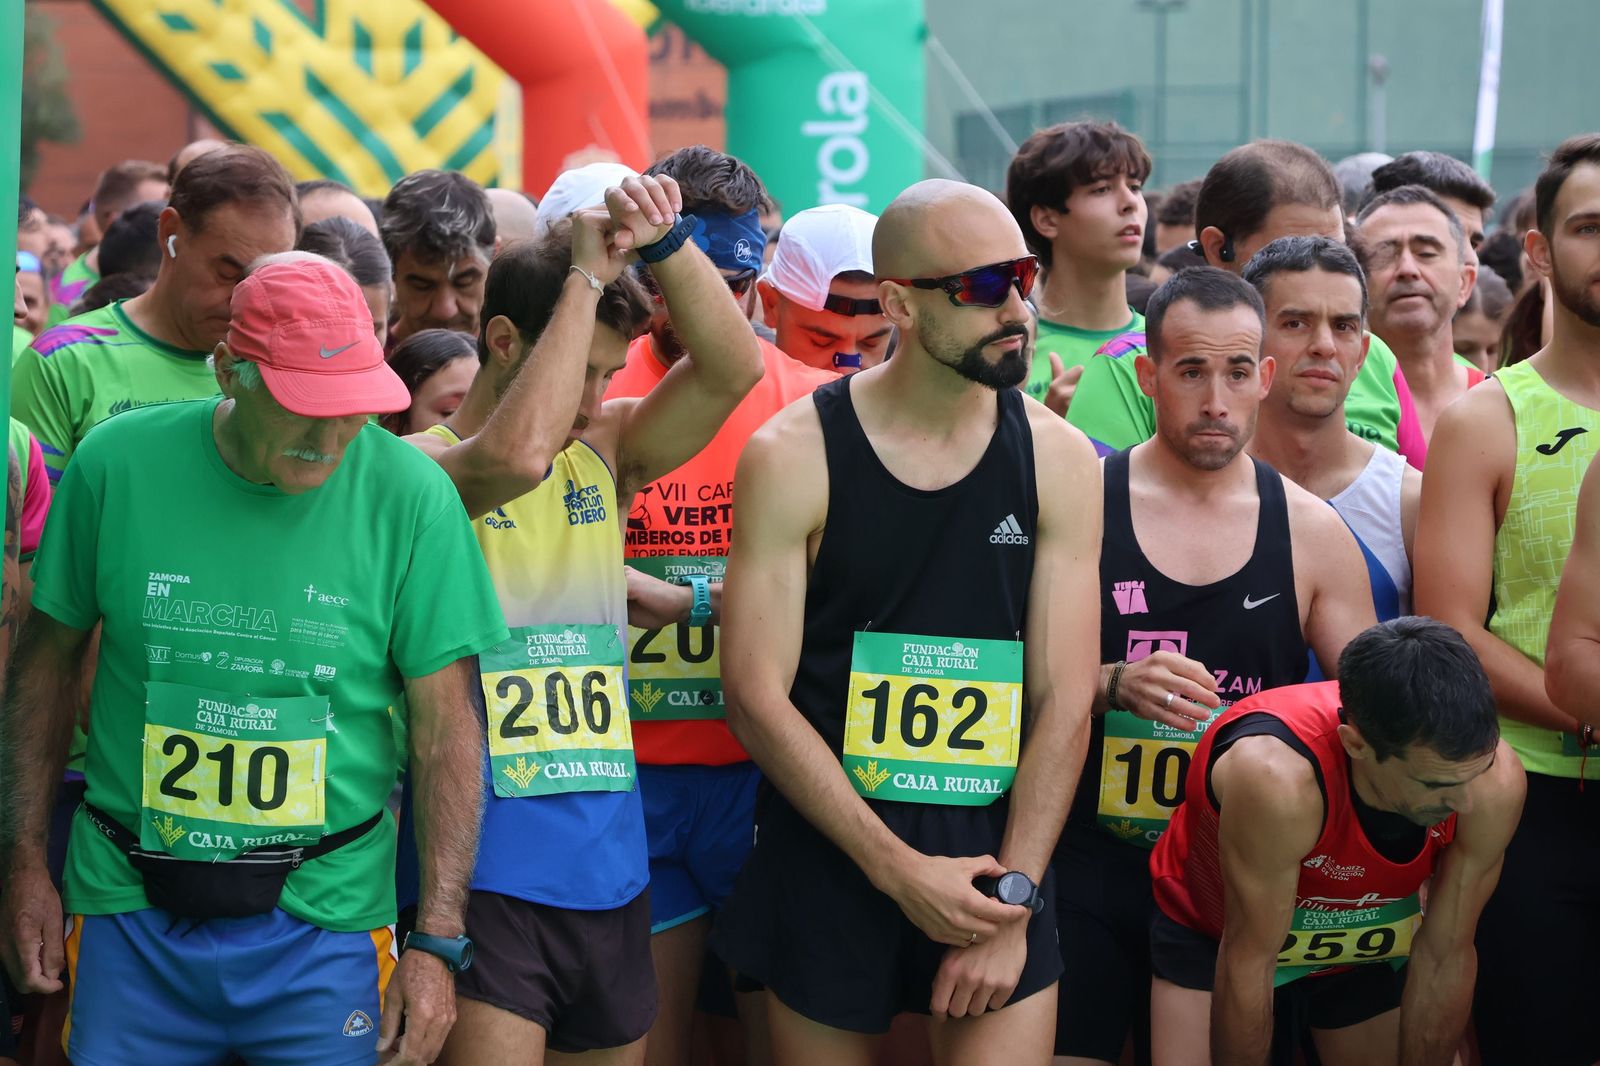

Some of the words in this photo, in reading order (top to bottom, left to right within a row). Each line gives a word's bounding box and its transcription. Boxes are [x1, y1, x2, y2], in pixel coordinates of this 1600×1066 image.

[657, 482, 686, 501] VII
[663, 503, 732, 526] VERT
[700, 529, 722, 546] DE
[989, 532, 1029, 545] adidas
[148, 572, 191, 584] ZAMORA
[147, 582, 171, 597] EN
[318, 593, 350, 606] aecc
[143, 597, 278, 633] MARCHA
[231, 663, 264, 674] ZAMORA
[314, 664, 337, 676] gaza
[902, 654, 933, 668] CAJA
[937, 656, 979, 670] RURAL
[914, 668, 945, 676] ZAMORA
[495, 670, 611, 739] 206
[667, 690, 714, 706] CAJ
[197, 711, 226, 727] CAJA
[230, 718, 277, 731] RURAL
[862, 680, 988, 751] 162
[195, 723, 205, 731] DE
[207, 725, 238, 737] ZAMORA
[160, 734, 290, 811] 210
[544, 762, 586, 779] CAJA
[587, 761, 627, 778] RURAL
[893, 773, 939, 791] CAJA
[944, 776, 1003, 794] RURAL
[188, 831, 237, 850] CAJA
[1338, 911, 1380, 924] RURAL
